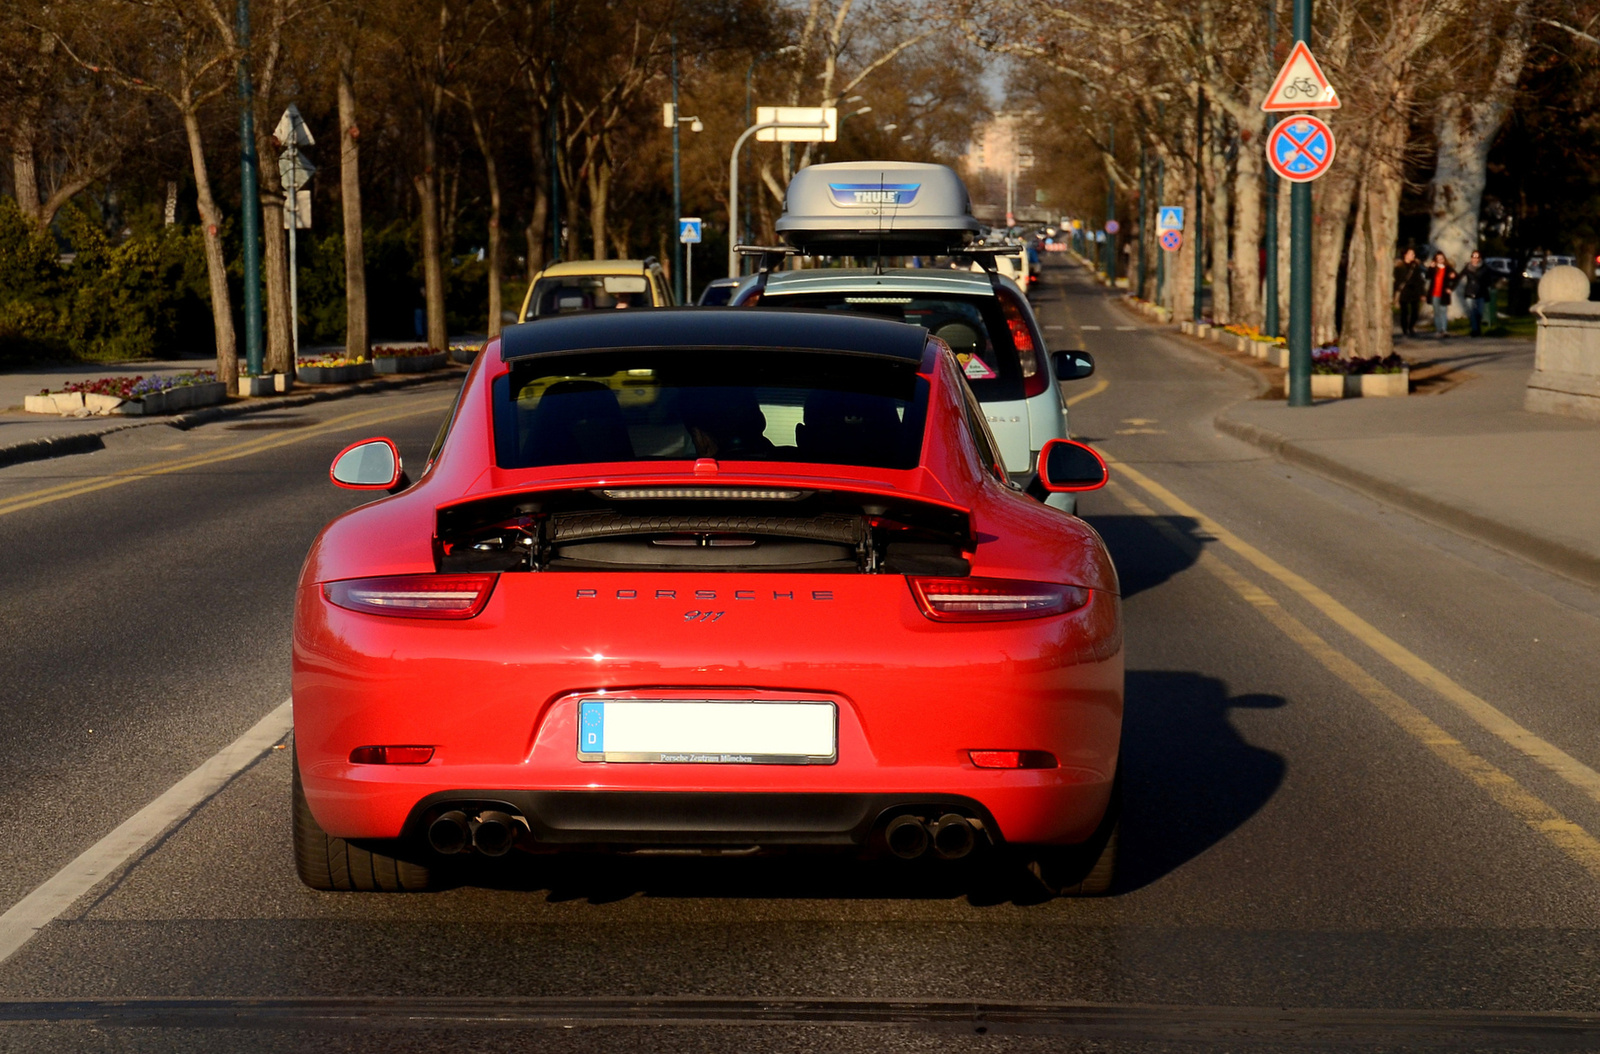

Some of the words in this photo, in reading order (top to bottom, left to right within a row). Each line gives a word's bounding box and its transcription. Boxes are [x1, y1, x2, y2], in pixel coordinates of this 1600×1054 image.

[853, 191, 896, 203] THULE
[575, 589, 834, 600] PORSCHE
[684, 610, 725, 622] 911
[588, 732, 597, 744] D
[660, 754, 688, 763] Porsche
